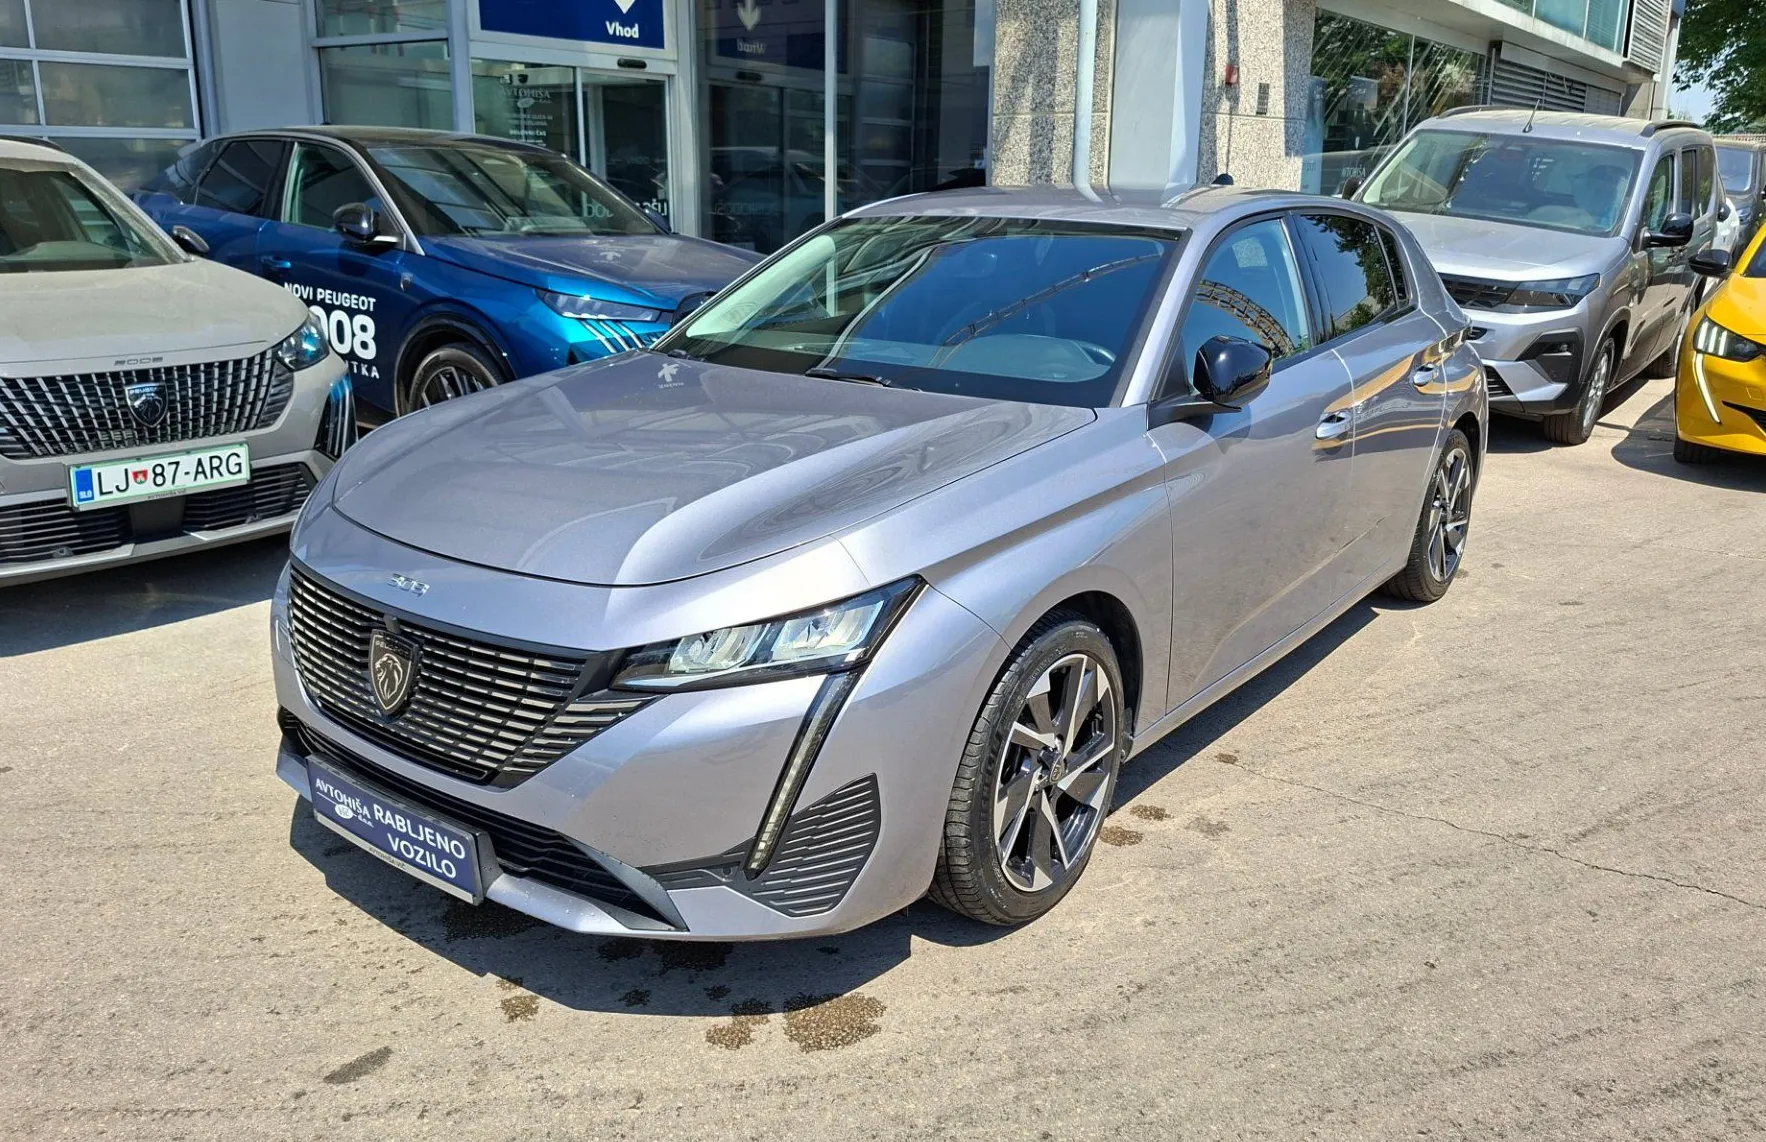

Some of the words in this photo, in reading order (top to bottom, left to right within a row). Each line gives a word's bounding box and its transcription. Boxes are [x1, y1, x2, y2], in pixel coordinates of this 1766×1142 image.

[605, 21, 640, 39] Vhod
[316, 287, 376, 312] PEUGEOT
[97, 467, 130, 496] LJ
[152, 452, 243, 487] 87-ARG
[315, 778, 371, 819] AVTOHIŠA
[373, 804, 466, 859] RABLJENO
[387, 833, 457, 879] VOZILO
